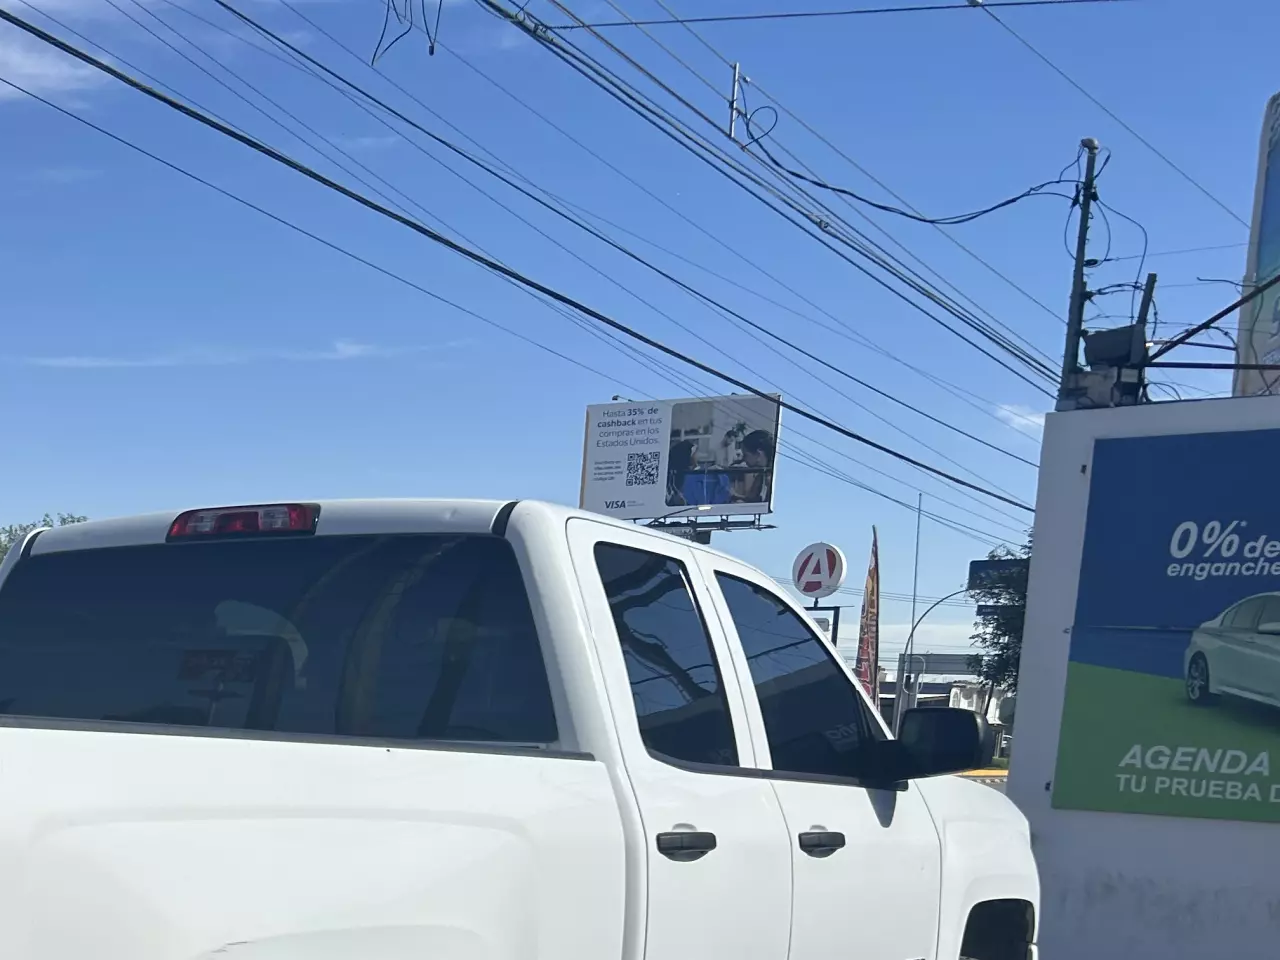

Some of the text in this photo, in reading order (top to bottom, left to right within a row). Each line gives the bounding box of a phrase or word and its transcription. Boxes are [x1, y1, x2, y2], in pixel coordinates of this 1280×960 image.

[647, 407, 659, 415] de
[597, 418, 636, 428] cashback
[596, 439, 628, 448] Estados
[604, 500, 626, 509] VISA
[1243, 535, 1280, 558] de
[1167, 557, 1280, 580] enganche
[1118, 744, 1270, 776] AGENDA
[1115, 774, 1147, 793] TU
[1154, 776, 1262, 802] PRUEBA
